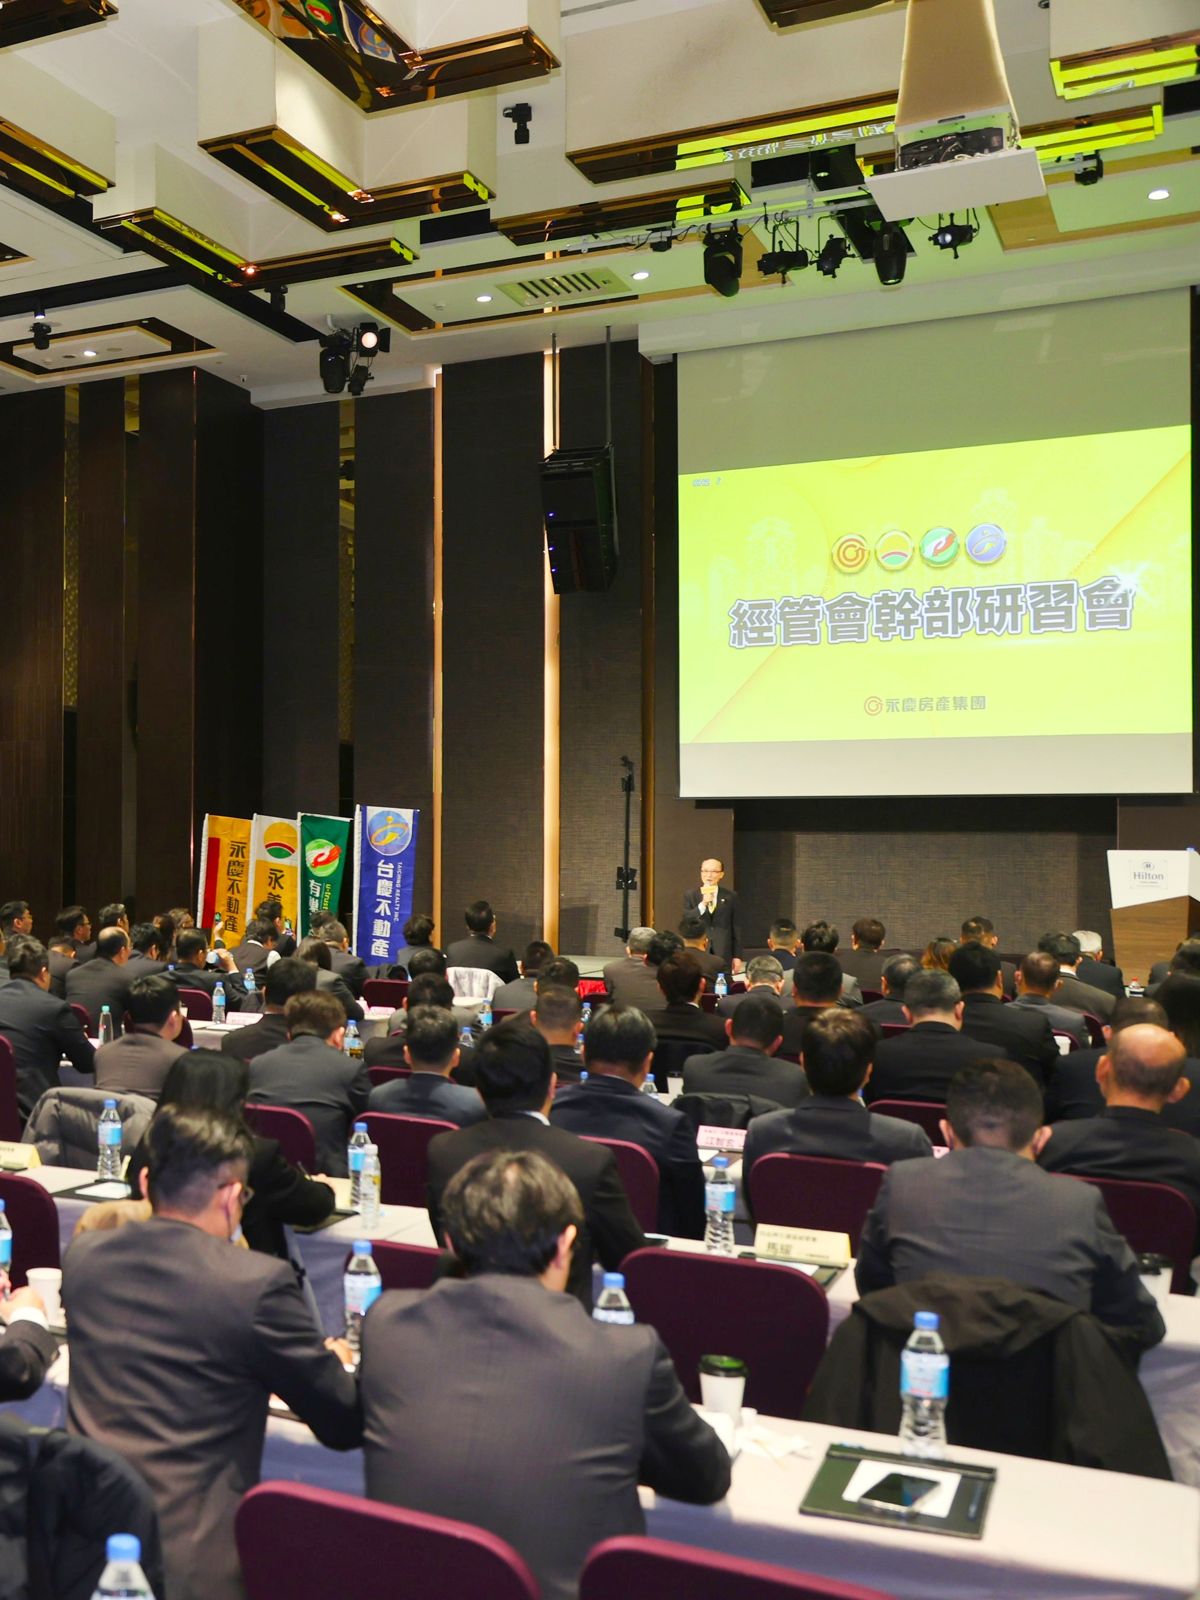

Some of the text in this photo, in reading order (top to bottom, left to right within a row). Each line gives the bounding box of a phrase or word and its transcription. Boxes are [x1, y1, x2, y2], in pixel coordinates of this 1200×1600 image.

[728, 575, 1137, 649] 經管會幹部研習會
[885, 695, 987, 714] 永慶房產集團
[224, 840, 247, 933] 永慶不動產
[371, 859, 394, 957] 台慶不動產
[1133, 871, 1164, 881] Hilton
